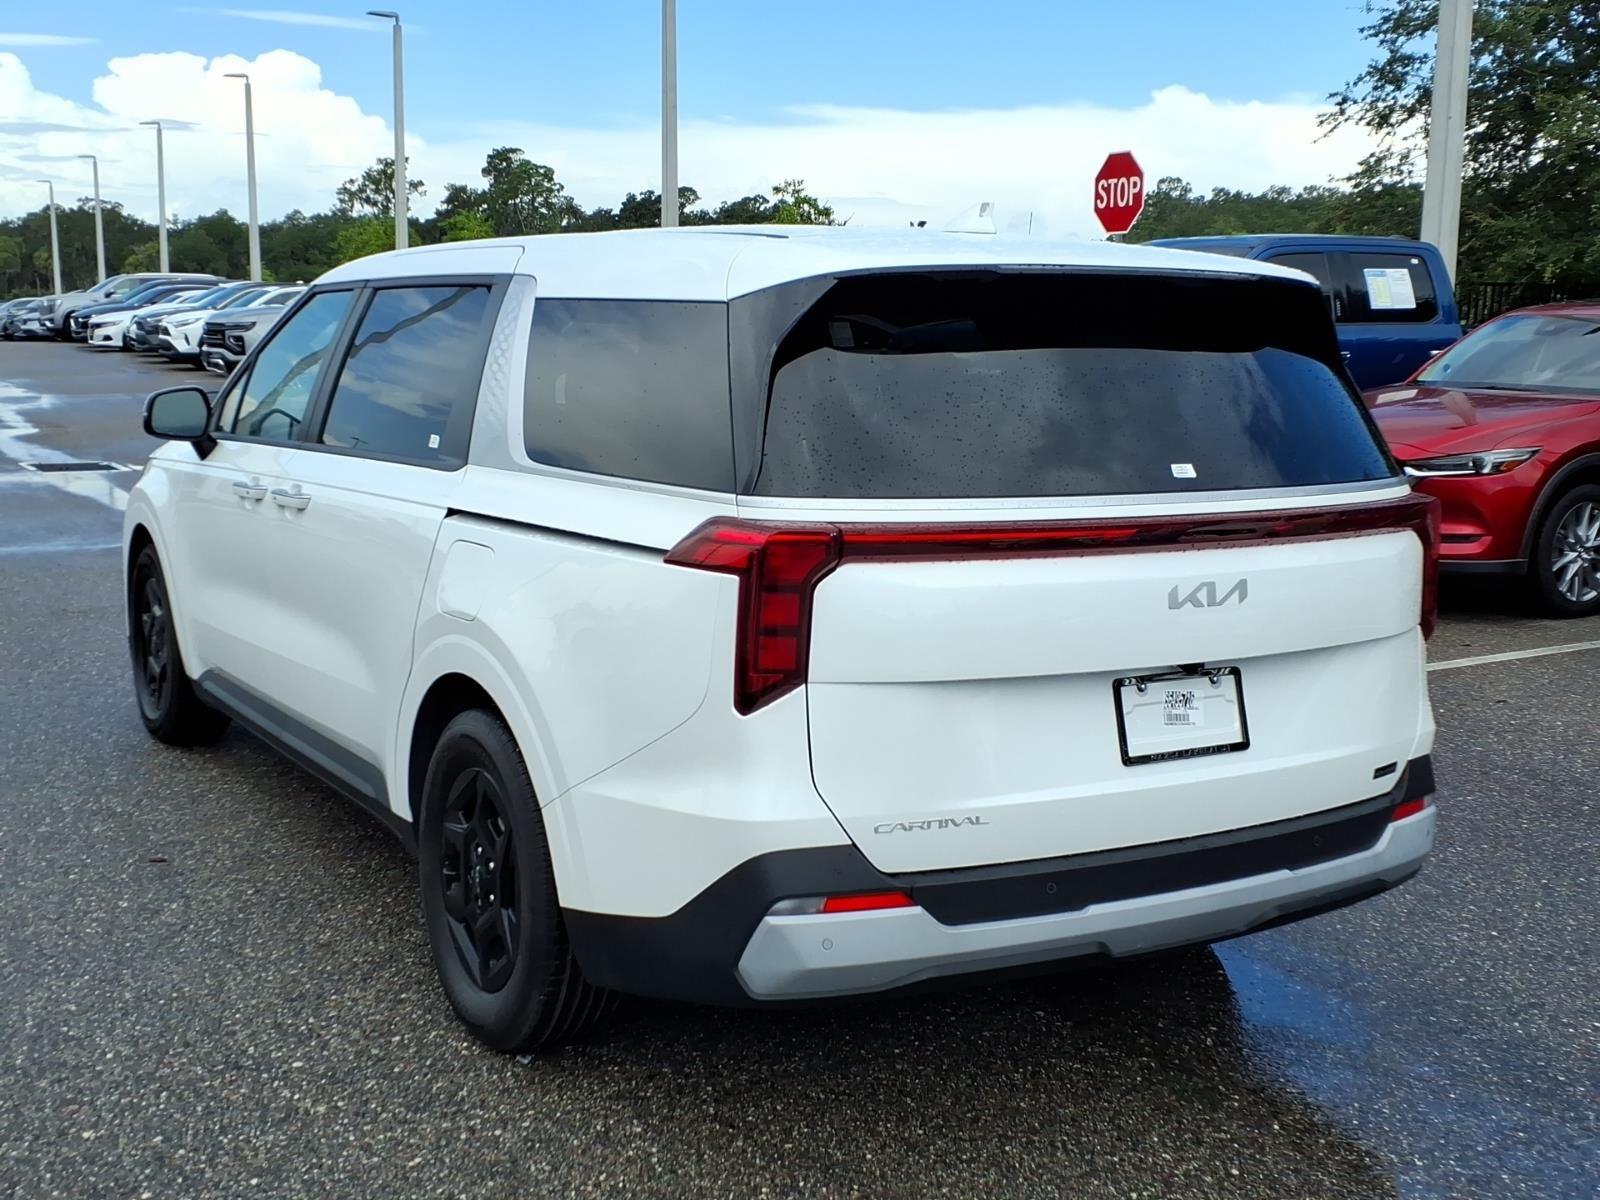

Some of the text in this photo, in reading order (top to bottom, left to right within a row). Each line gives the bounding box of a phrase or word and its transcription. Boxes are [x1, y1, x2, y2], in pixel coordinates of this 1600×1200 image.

[1096, 176, 1141, 209] STOP
[1168, 578, 1248, 610] KIA
[873, 815, 990, 834] CARNIVAL
